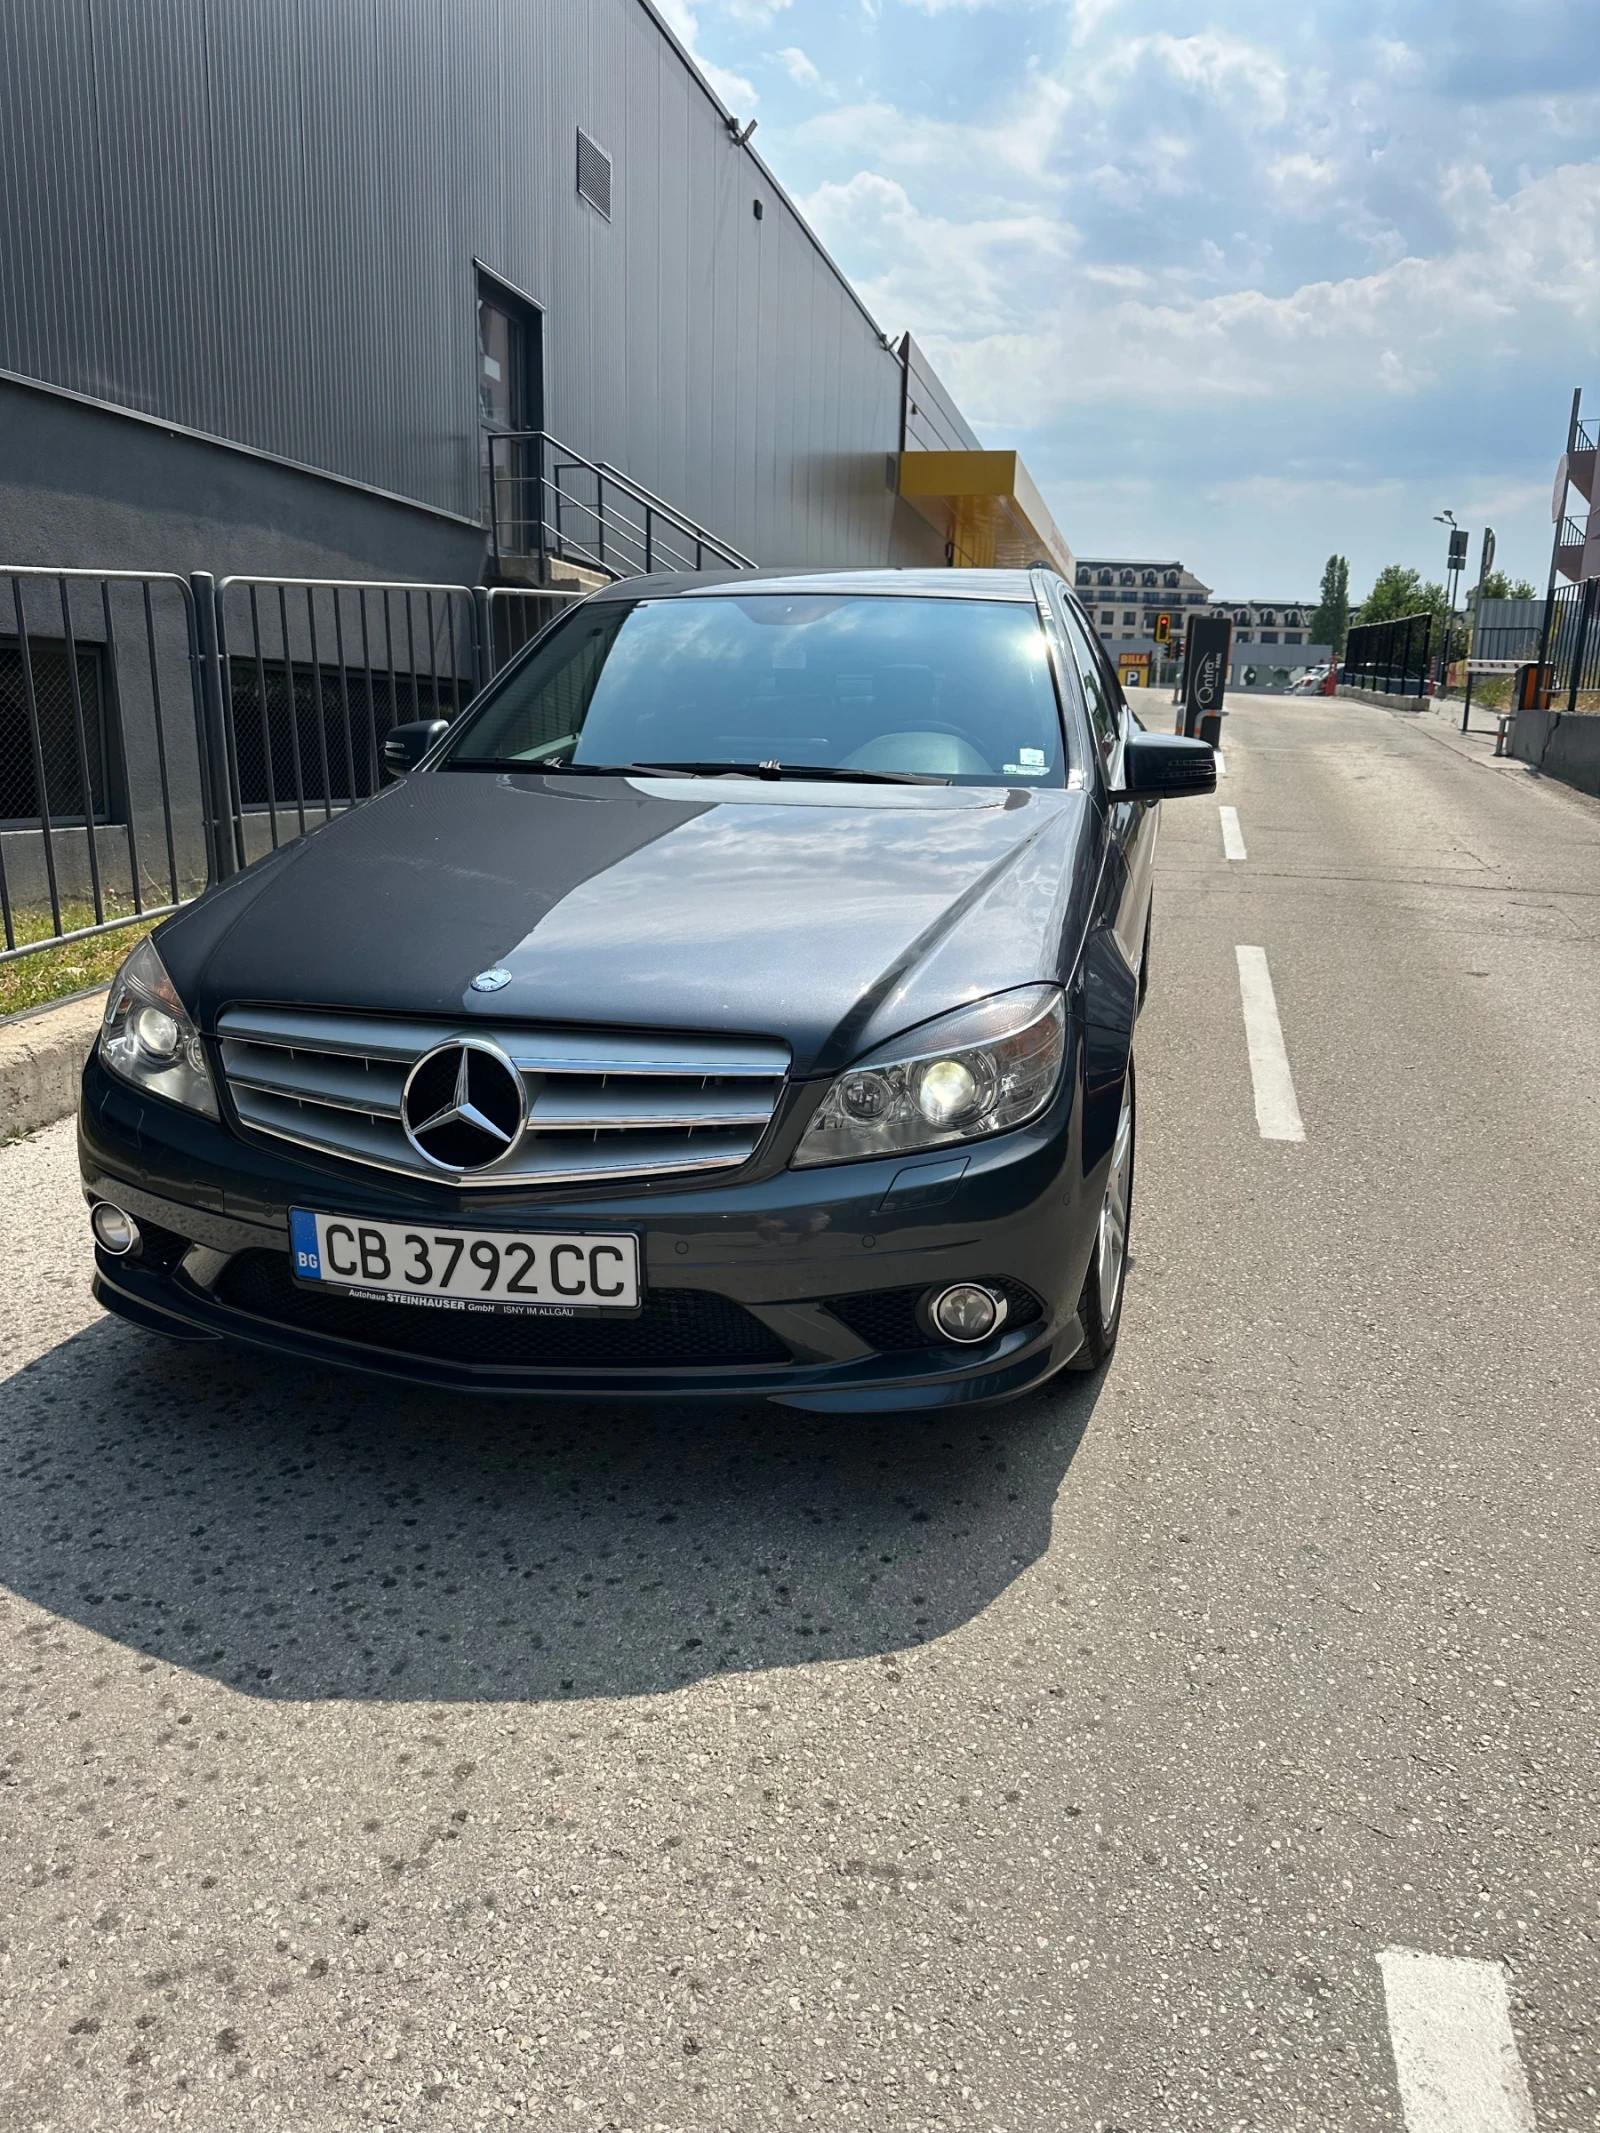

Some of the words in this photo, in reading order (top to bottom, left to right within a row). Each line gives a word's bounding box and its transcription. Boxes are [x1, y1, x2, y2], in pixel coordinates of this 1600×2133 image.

[1120, 654, 1148, 664] BILLA
[1127, 671, 1138, 685] P
[298, 1251, 318, 1269] BG
[326, 1224, 391, 1280] CB
[404, 1234, 538, 1294] 3792
[549, 1244, 625, 1297] CC
[348, 1289, 386, 1301] Autohaus
[387, 1293, 465, 1310] STEINHAUSER
[467, 1303, 495, 1313] GmbH
[503, 1305, 524, 1315] ISNY
[526, 1307, 537, 1315] IM
